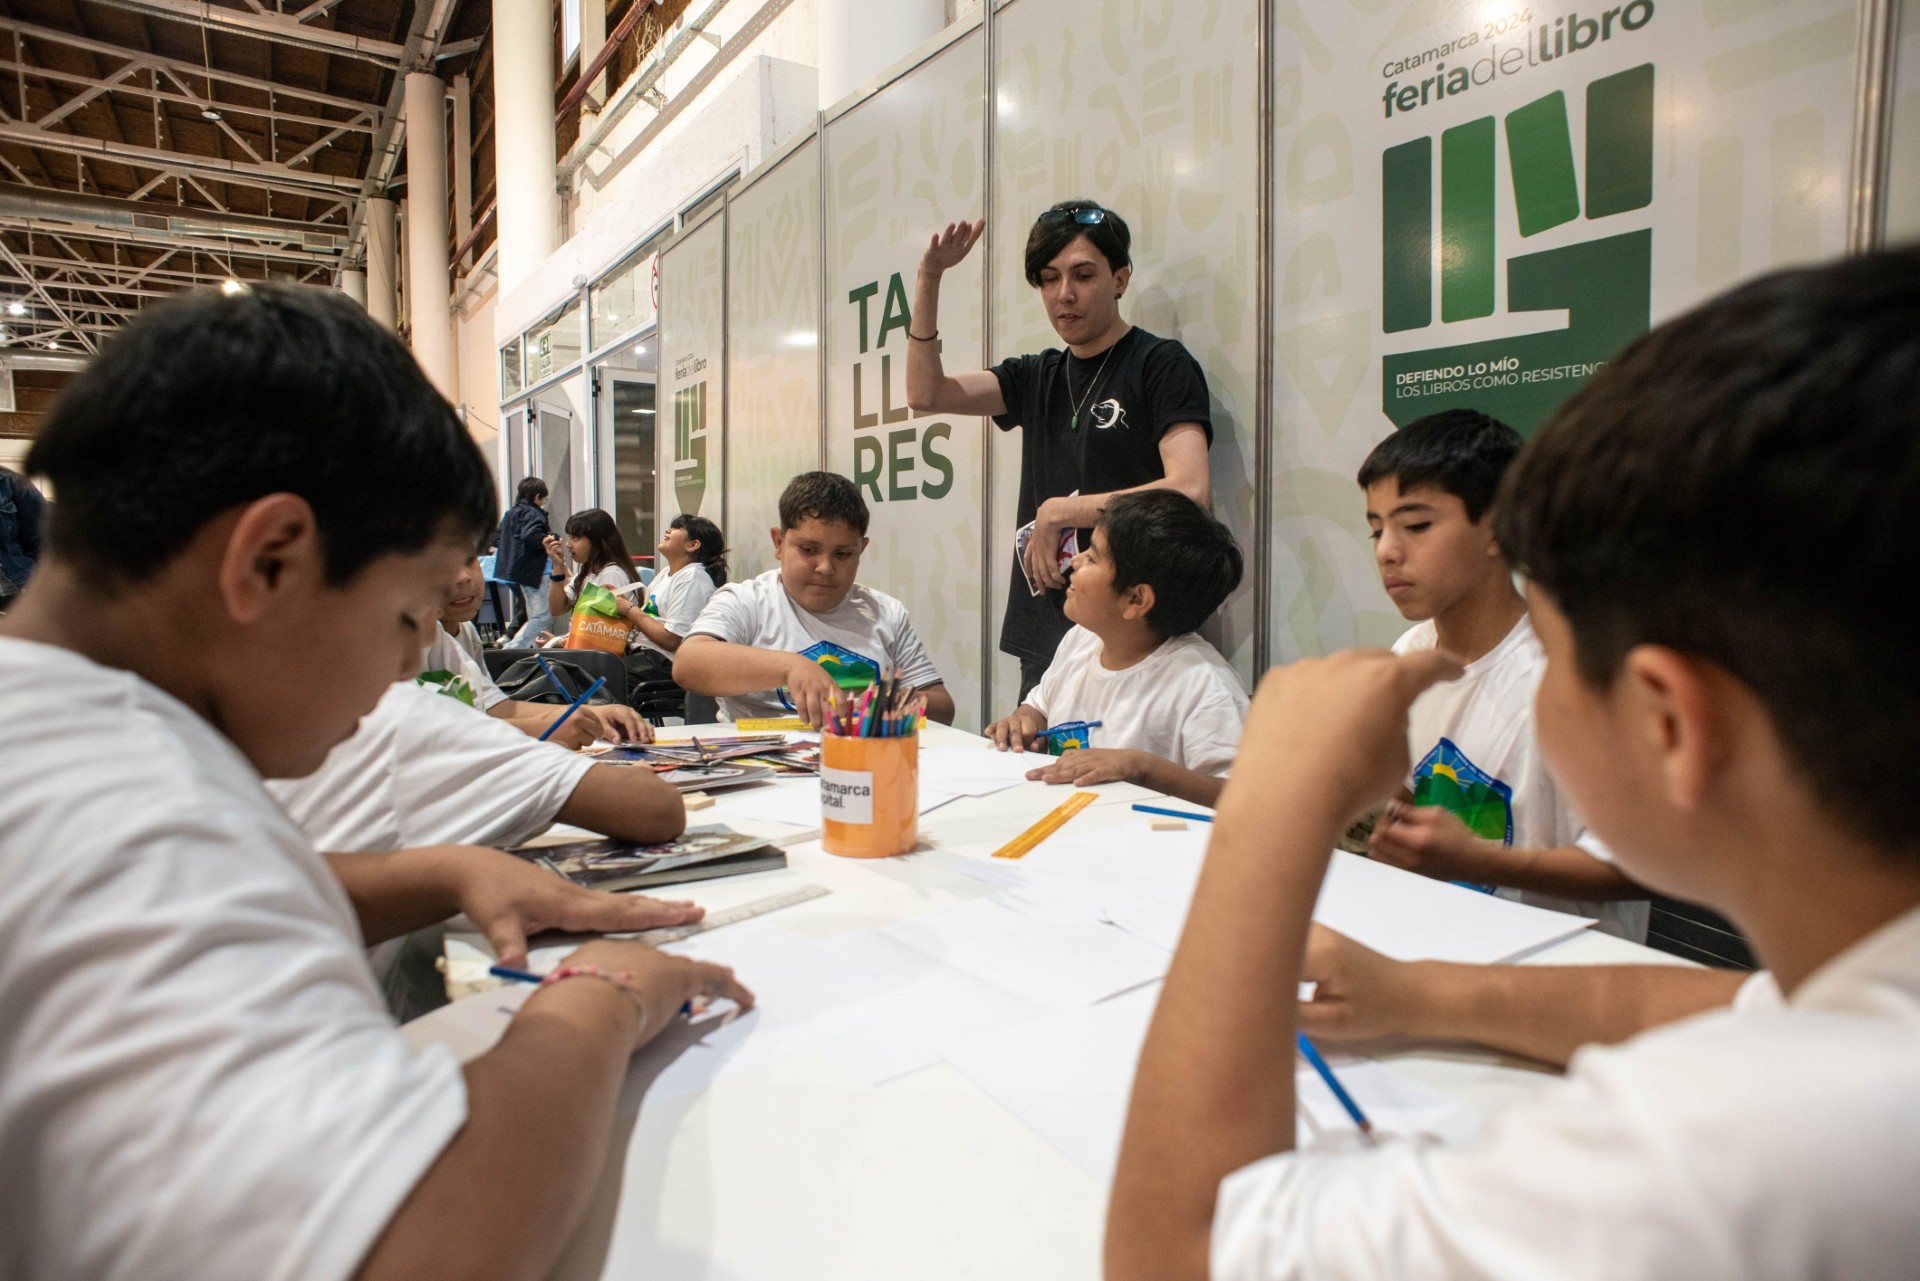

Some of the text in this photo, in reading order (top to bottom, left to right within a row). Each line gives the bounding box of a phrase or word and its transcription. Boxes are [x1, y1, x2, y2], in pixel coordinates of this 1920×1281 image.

[1382, 7, 1534, 78] Catamarca 2024
[849, 272, 912, 354] TA
[853, 340, 942, 430] LL
[1396, 356, 1519, 385] DEFIENDO LO MÍO
[1396, 361, 1609, 399] LOS LIBROS COMO RESISTENC
[853, 422, 954, 502] RES
[578, 619, 630, 640] CATAMARC
